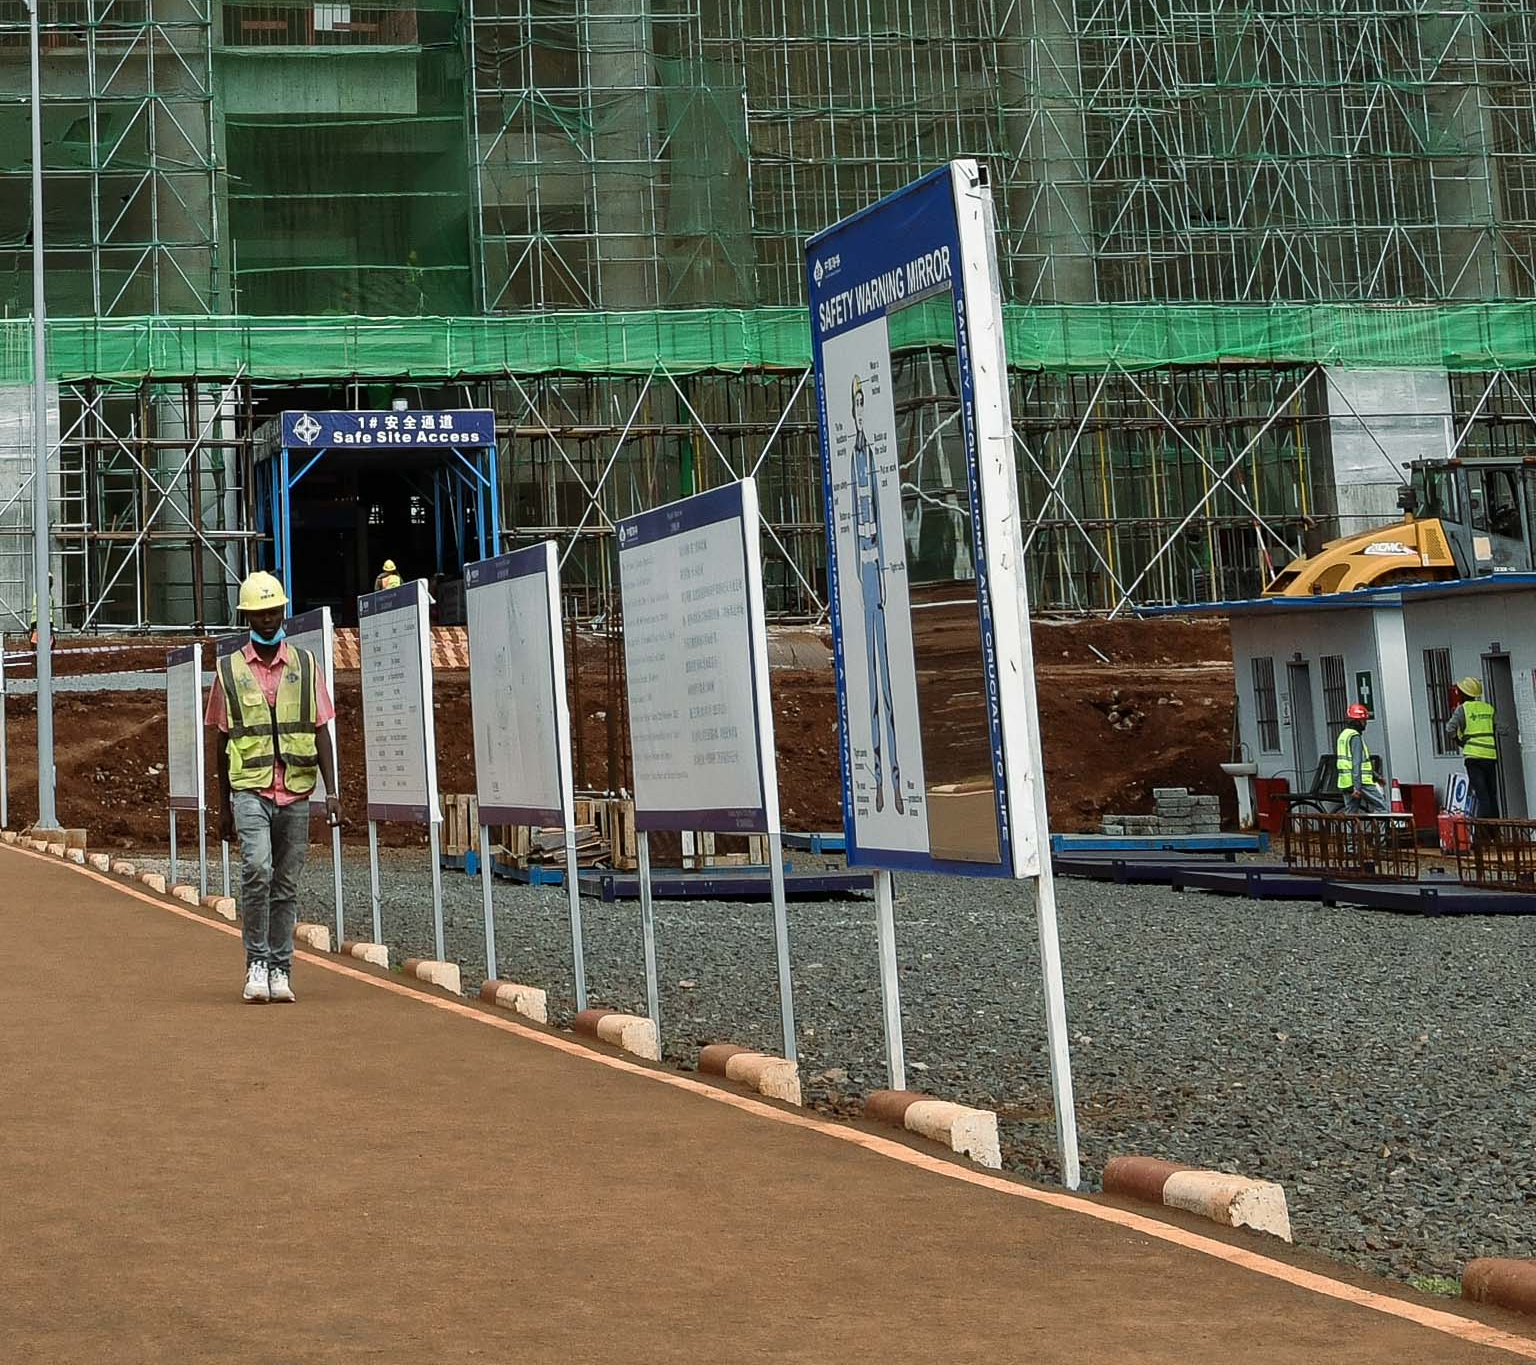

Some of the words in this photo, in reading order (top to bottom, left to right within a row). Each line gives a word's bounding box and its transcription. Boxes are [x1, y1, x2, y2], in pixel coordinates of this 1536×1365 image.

[819, 288, 854, 333] SAFETY
[855, 267, 905, 316] WARNING
[906, 245, 953, 295] MIRROR
[333, 431, 372, 444] Safe
[377, 431, 412, 443] Site
[416, 431, 480, 443] Access
[385, 415, 453, 429] 安全通道
[978, 573, 991, 620] ARE
[986, 632, 1000, 733] CRUCIAL
[995, 745, 1005, 778] TO
[999, 789, 1009, 841] LIFE
